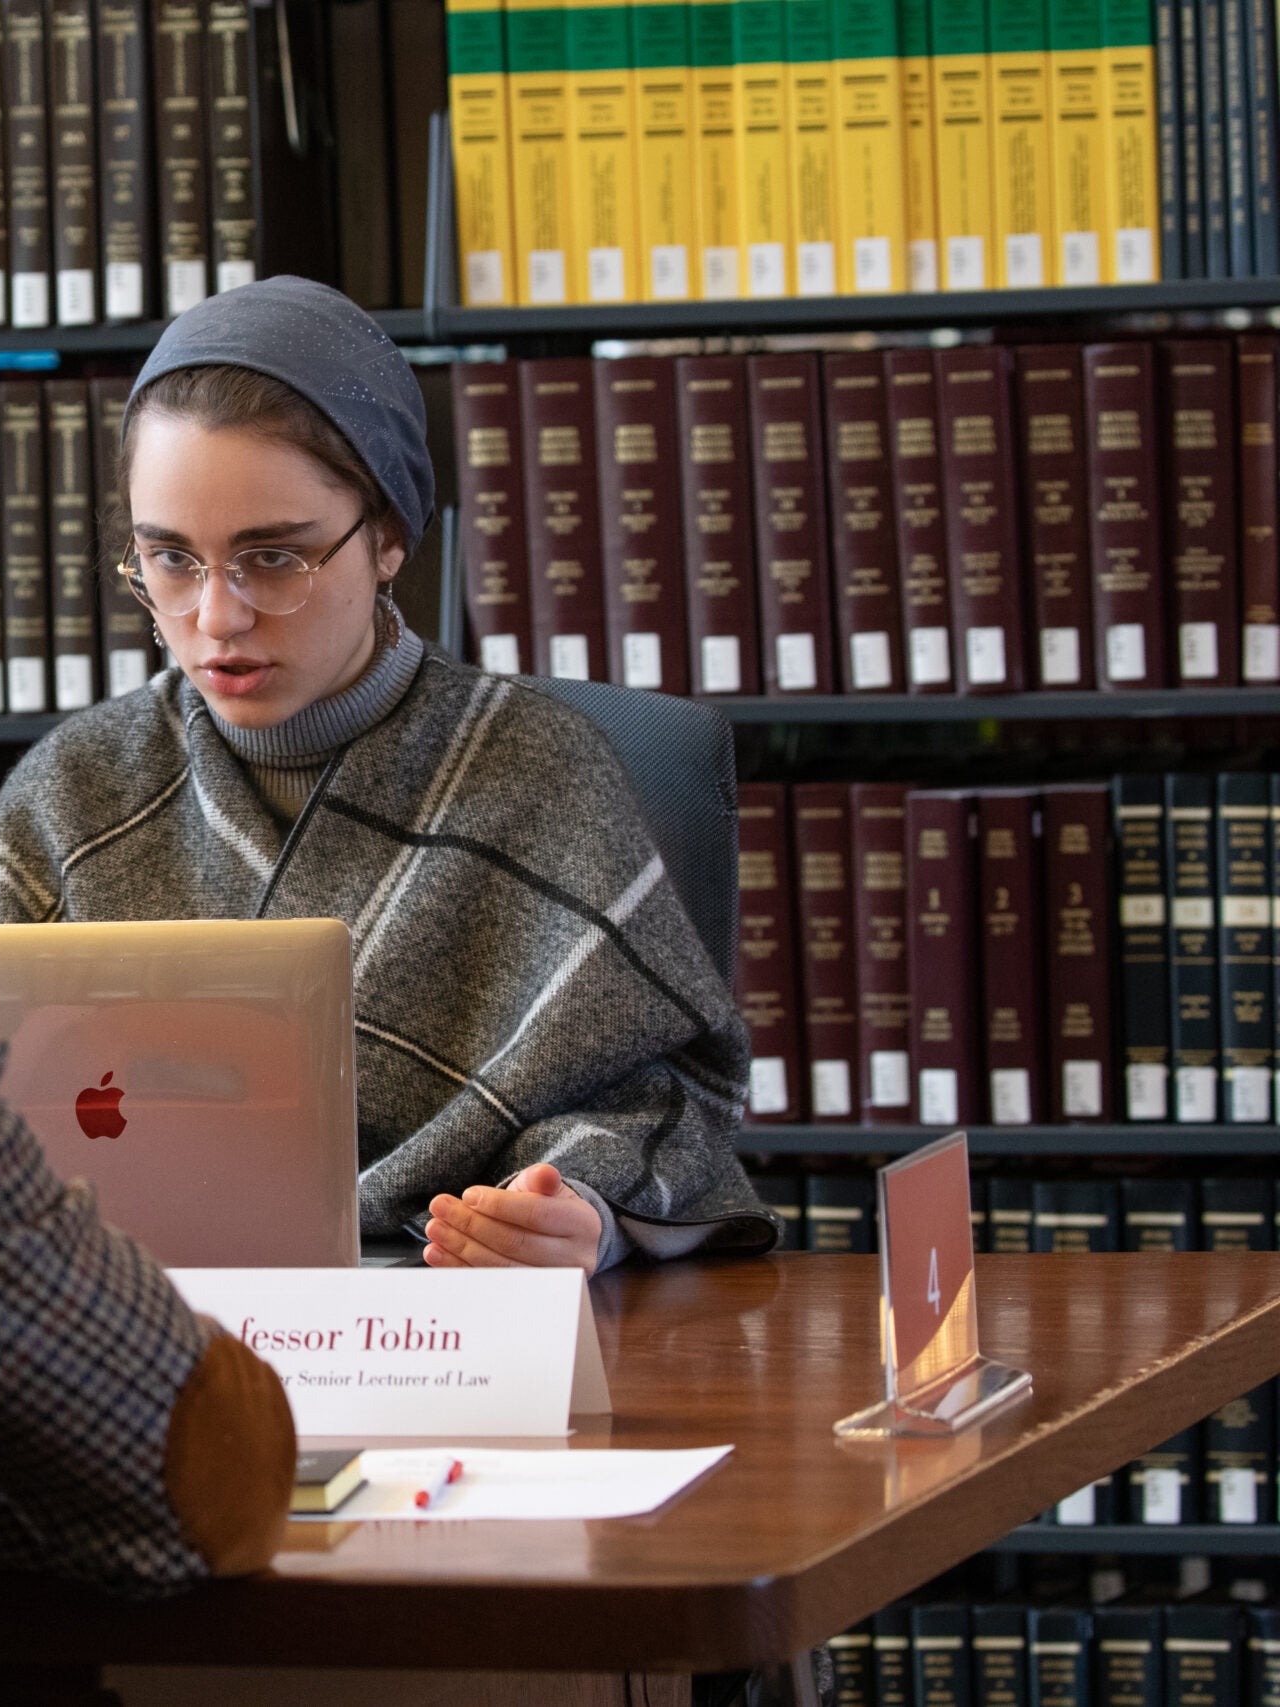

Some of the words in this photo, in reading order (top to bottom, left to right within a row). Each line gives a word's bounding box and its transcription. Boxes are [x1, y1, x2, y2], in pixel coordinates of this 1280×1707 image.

[927, 1247, 941, 1315] 4
[240, 1317, 343, 1351] fessor
[356, 1317, 462, 1351] Tobin
[297, 1370, 352, 1387] Senior
[358, 1370, 428, 1387] Lecturer
[434, 1370, 452, 1387] of
[457, 1370, 492, 1387] Law
